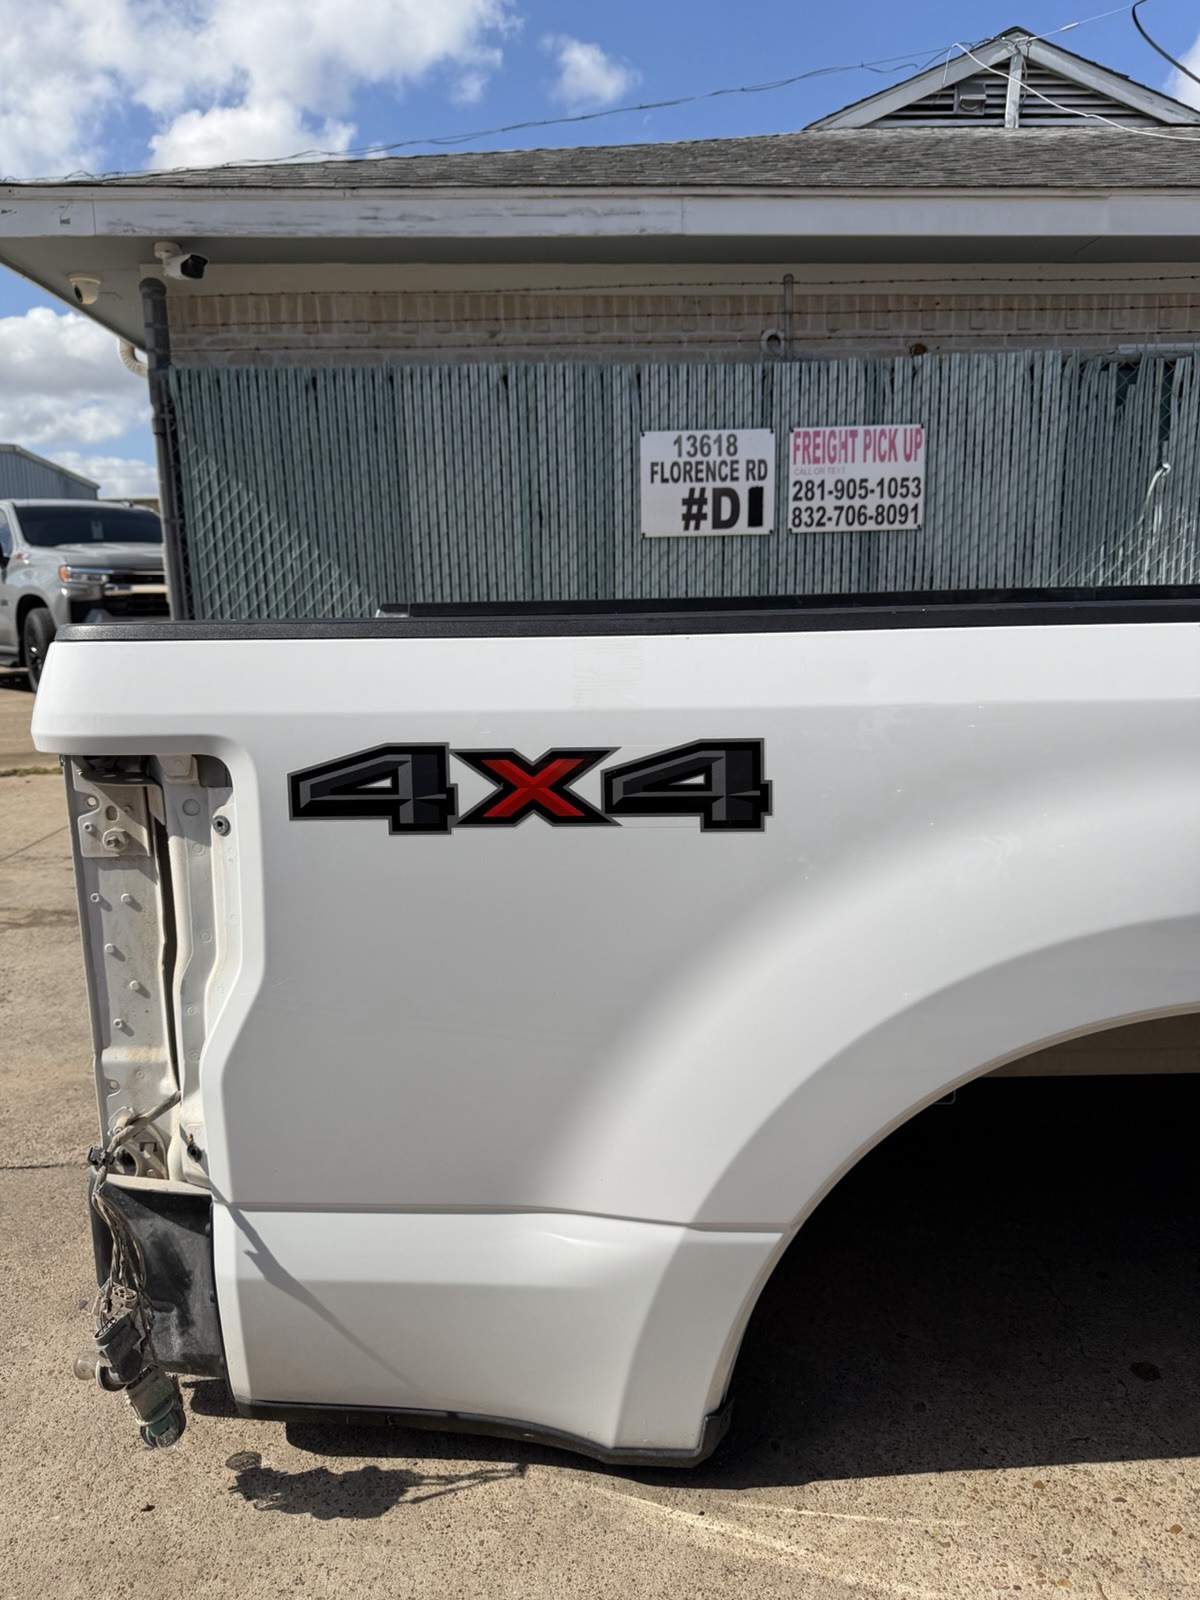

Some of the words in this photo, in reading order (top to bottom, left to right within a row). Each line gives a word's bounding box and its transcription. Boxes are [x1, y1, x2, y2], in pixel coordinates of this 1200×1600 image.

[673, 433, 738, 458] 13618
[792, 429, 858, 465] FREIGHT
[863, 428, 898, 463] PICK
[903, 427, 922, 462] UP
[650, 460, 740, 484] FLORENCE
[746, 459, 768, 481] RD
[793, 467, 813, 476] CALL
[814, 467, 825, 475] OR
[827, 466, 846, 475] TEXT
[792, 476, 921, 502] 281-905-1053
[791, 503, 919, 528] 832-706-8091
[287, 738, 773, 835] 4X4
